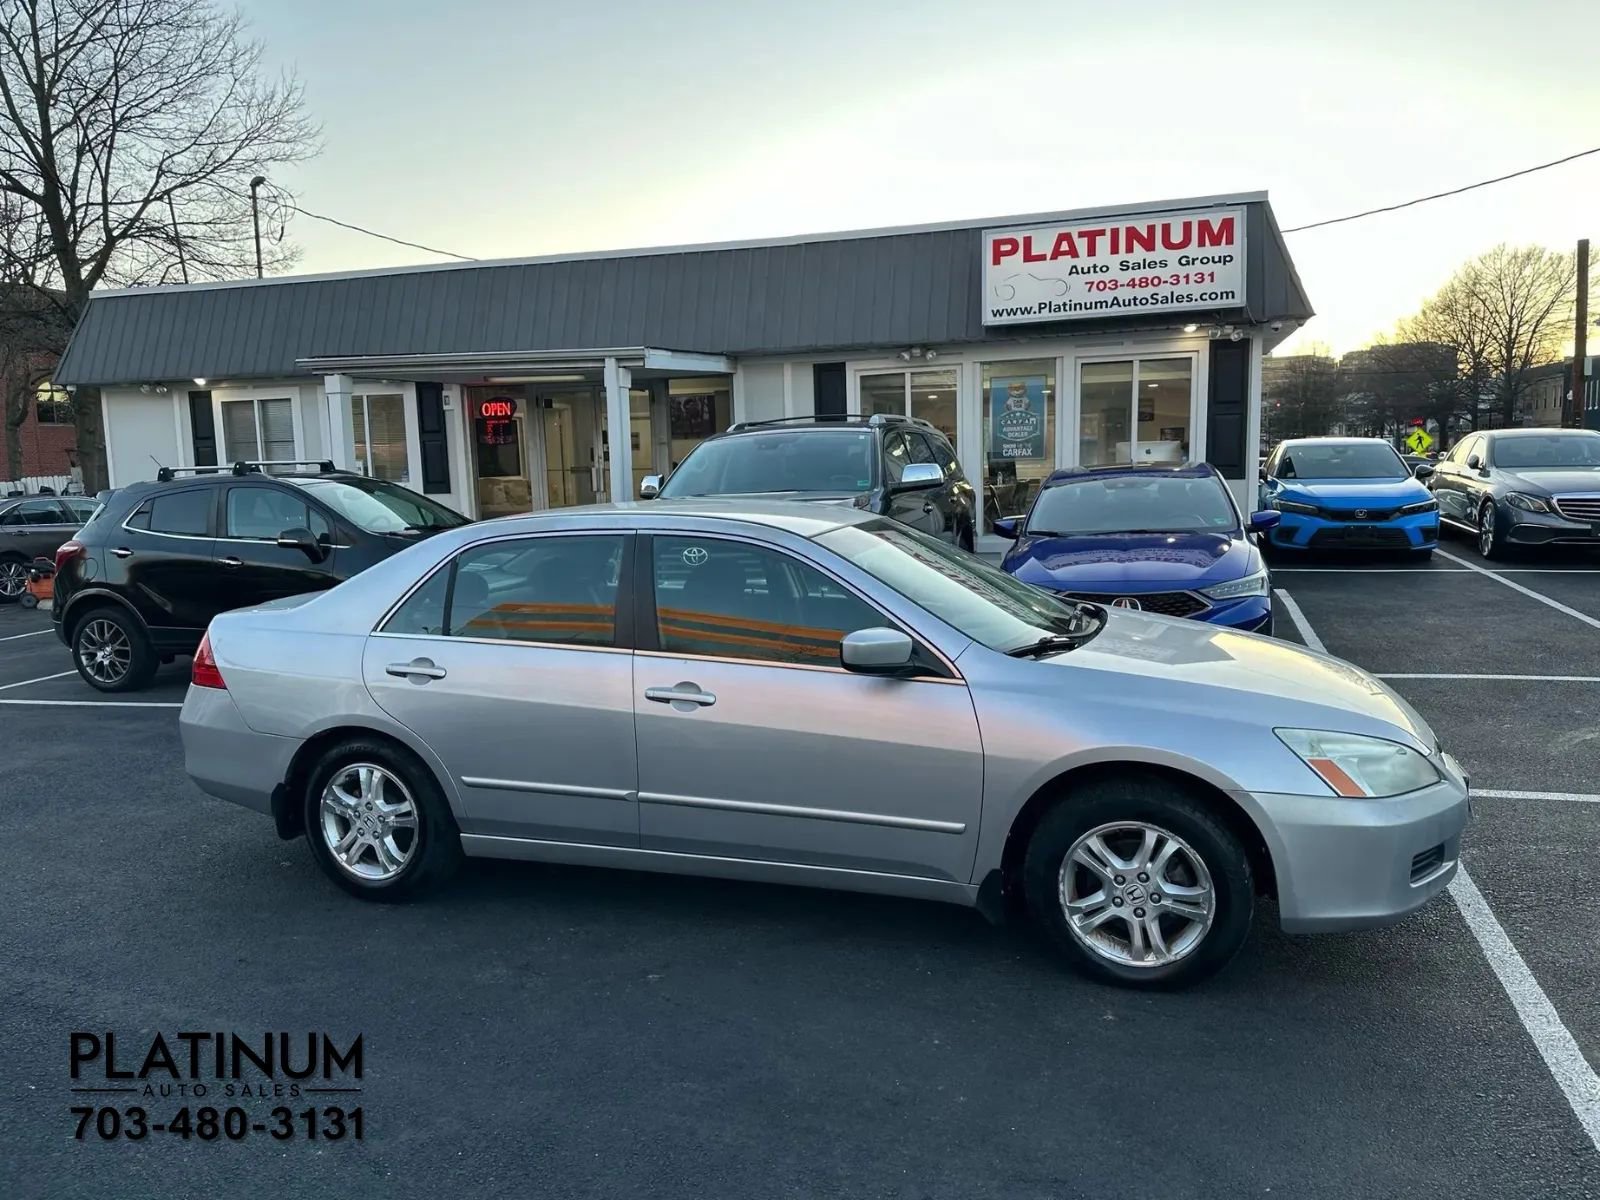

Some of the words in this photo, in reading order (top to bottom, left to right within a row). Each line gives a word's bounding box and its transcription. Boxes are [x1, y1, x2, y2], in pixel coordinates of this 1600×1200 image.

[992, 217, 1235, 266] PLATINUM
[1068, 263, 1110, 276] Auto
[1119, 258, 1168, 272] Sales
[1178, 254, 1234, 267] Group
[1085, 271, 1216, 292] 703-480-3131
[991, 290, 1235, 318] www.PlatinumAutoSales.com
[482, 402, 511, 416] OPEN
[1002, 448, 1033, 456] CARFAX
